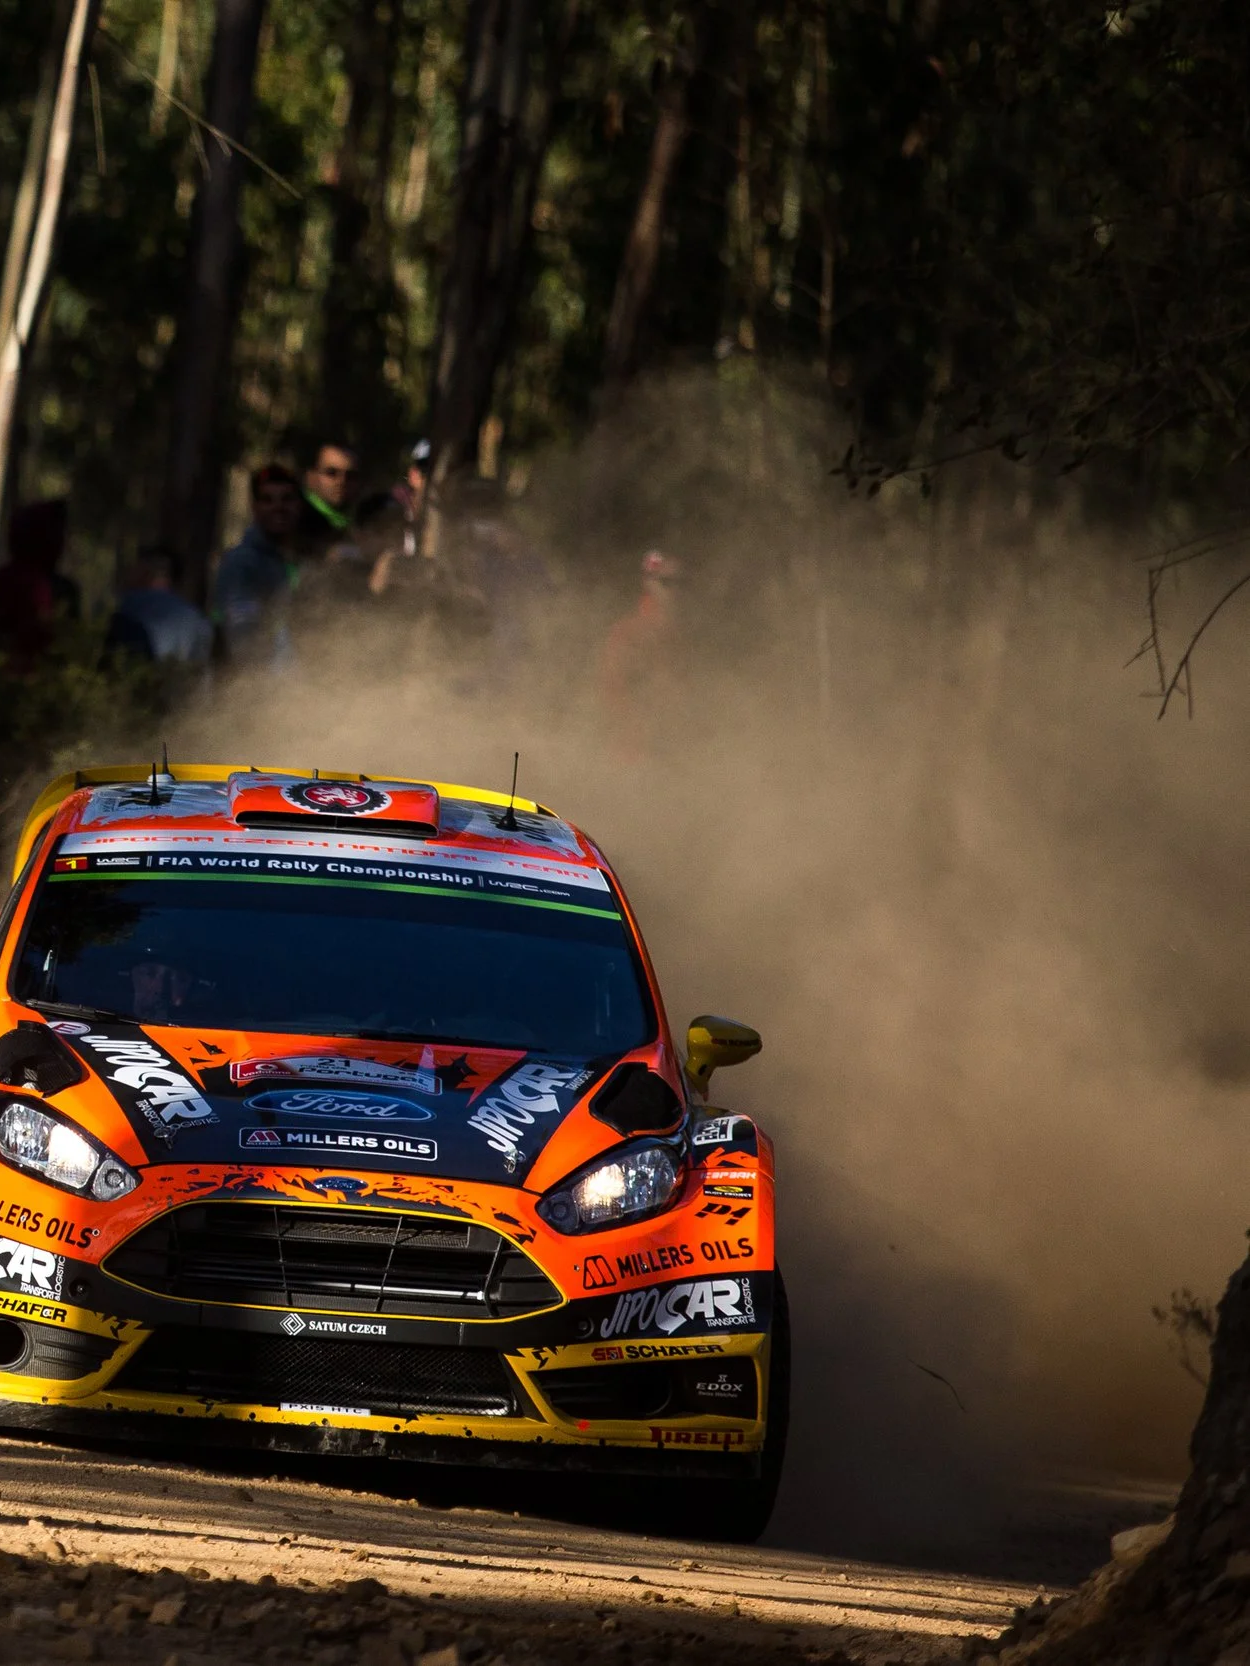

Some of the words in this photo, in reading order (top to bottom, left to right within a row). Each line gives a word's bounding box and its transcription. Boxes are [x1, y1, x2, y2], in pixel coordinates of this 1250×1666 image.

[158, 856, 193, 867] FIA
[199, 856, 260, 868] World
[267, 859, 319, 873] Rally
[326, 862, 474, 886] Championship
[500, 859, 590, 881] TEAM
[317, 1058, 351, 1068] 21
[280, 1092, 400, 1118] Ford
[286, 1132, 379, 1149] MILLERS
[383, 1139, 431, 1155] OILS
[45, 1217, 93, 1249] OILS
[616, 1244, 695, 1279] MILLERS
[700, 1237, 755, 1261] OILS
[308, 1320, 347, 1333] SATUM
[348, 1323, 387, 1335] CZECH
[705, 1315, 749, 1328] TRANSPORT
[695, 1381, 745, 1393] EDOX
[649, 1426, 745, 1446] PIRELLI
